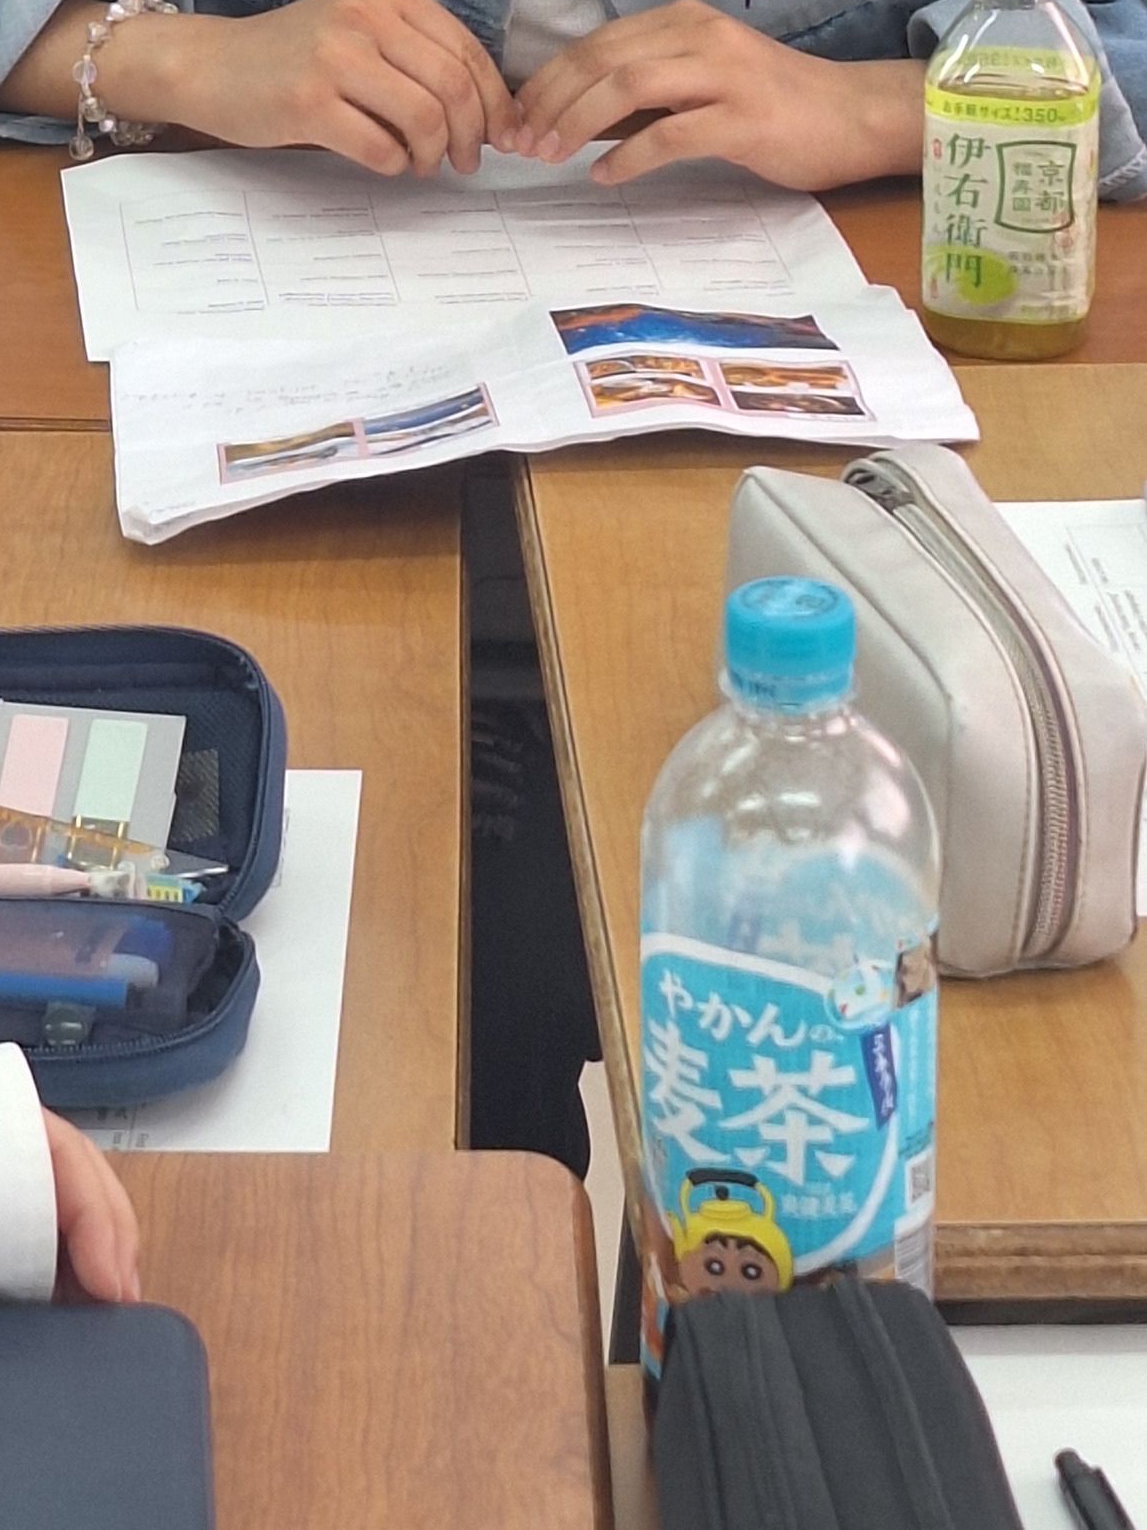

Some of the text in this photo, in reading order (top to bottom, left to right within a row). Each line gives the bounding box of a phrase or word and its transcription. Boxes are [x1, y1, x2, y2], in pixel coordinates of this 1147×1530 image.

[943, 132, 992, 289] 伊右衛門
[1034, 159, 1066, 215] 京都
[658, 967, 837, 1049] やかんの
[642, 1018, 870, 1188] 麦茶
